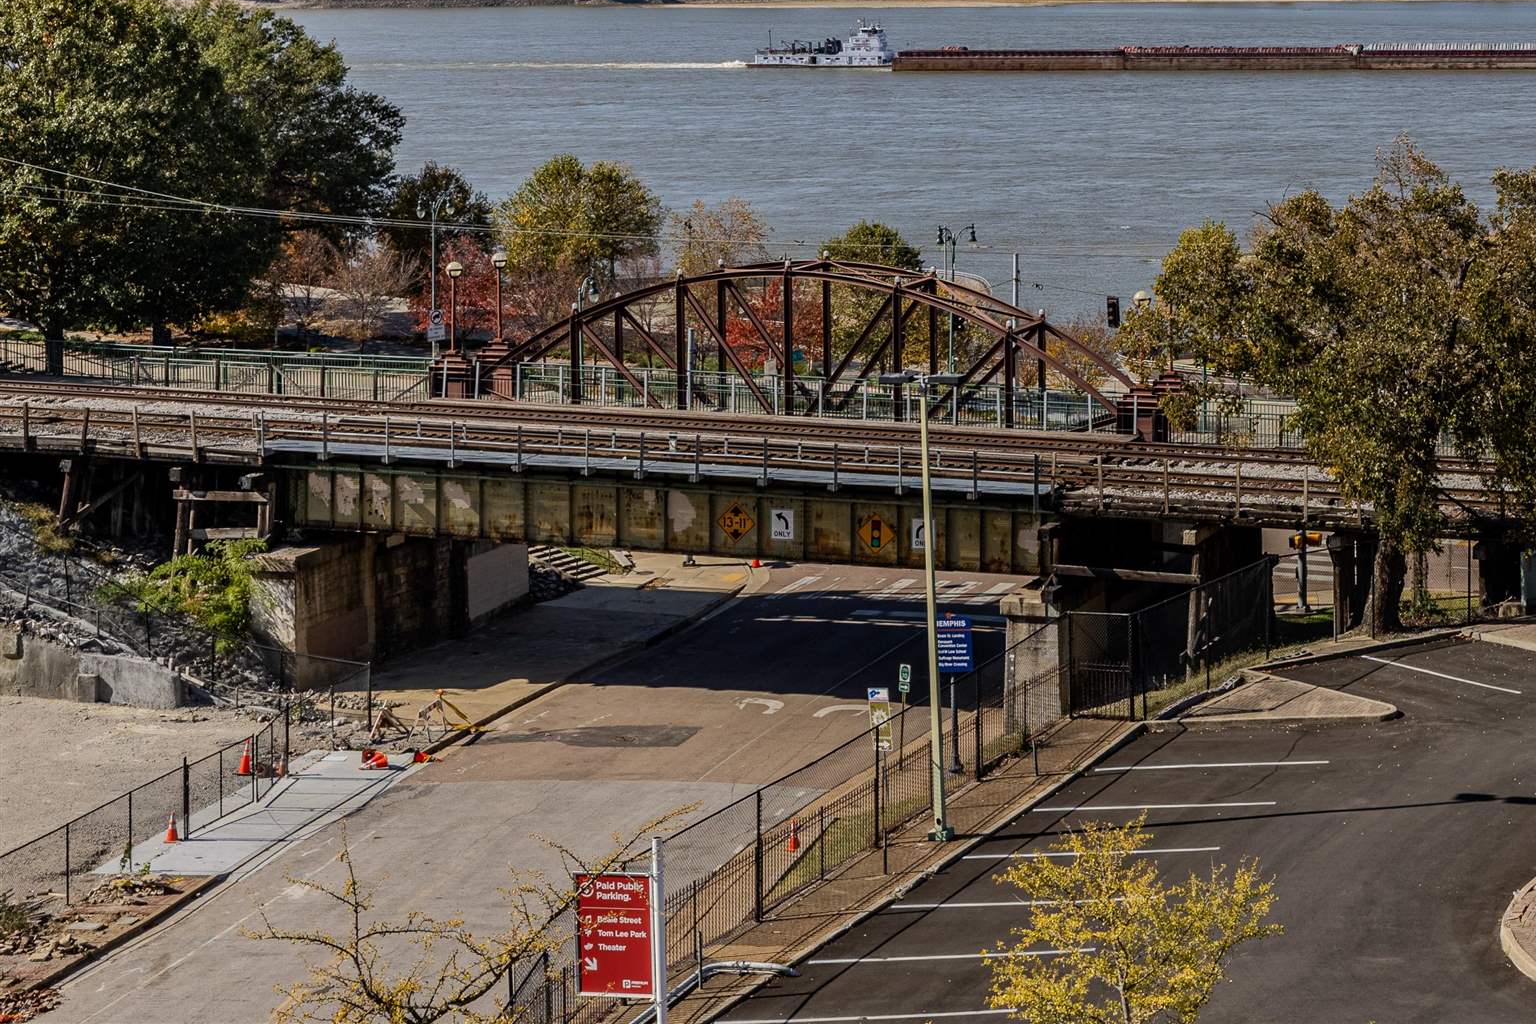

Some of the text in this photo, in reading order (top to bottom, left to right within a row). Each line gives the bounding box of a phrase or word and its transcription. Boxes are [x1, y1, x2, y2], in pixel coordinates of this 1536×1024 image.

[773, 530, 791, 538] ONLY
[596, 882, 615, 890] Paid
[597, 892, 632, 902] Parking.
[619, 916, 642, 924] Street
[597, 929, 614, 937] Tom
[630, 930, 647, 938] Park
[597, 943, 627, 951] Theater
